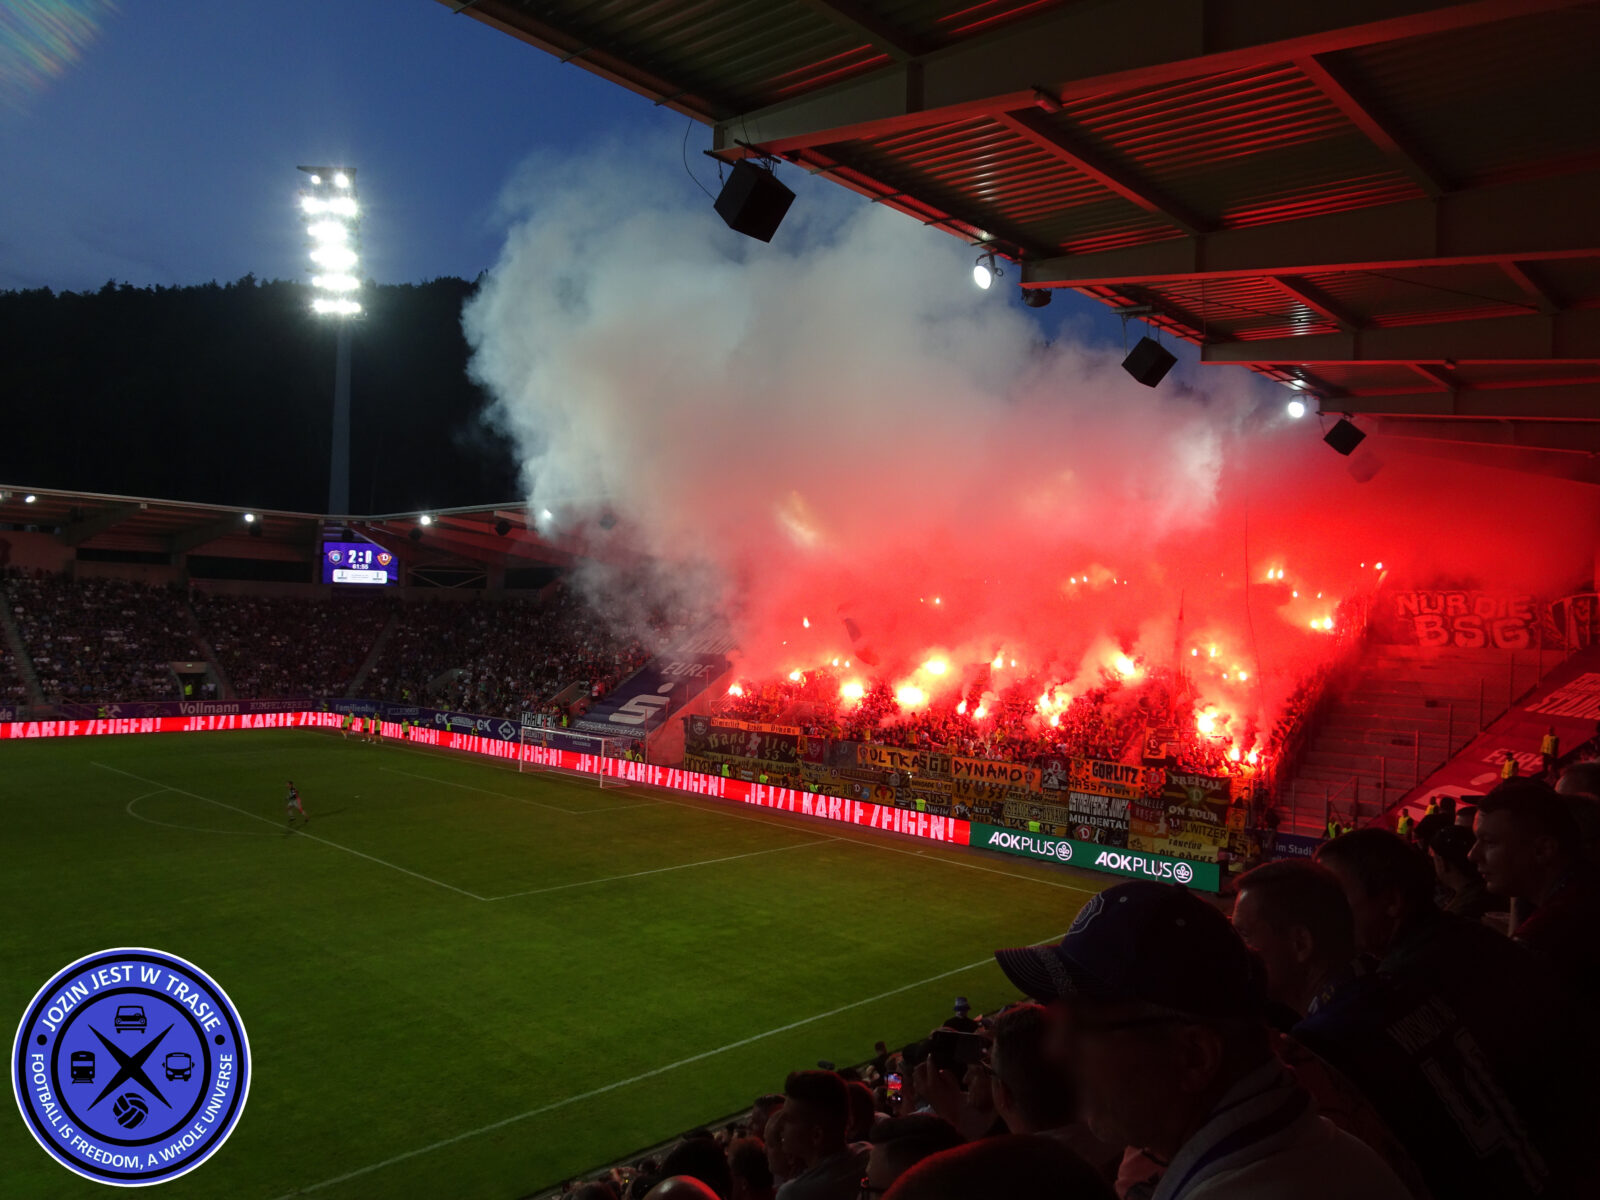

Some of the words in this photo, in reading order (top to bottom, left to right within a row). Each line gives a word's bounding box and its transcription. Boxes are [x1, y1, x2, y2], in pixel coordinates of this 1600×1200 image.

[1398, 593, 1468, 617] NUR
[1475, 595, 1535, 619] DIE
[1411, 614, 1530, 650] BSG
[179, 701, 240, 716] Vollmann
[953, 760, 1023, 782] DYNAMO
[1171, 775, 1223, 791] FREITAL
[1069, 813, 1129, 830] MULDENTAL
[1168, 805, 1186, 817] ON
[1186, 808, 1219, 823] TOUR
